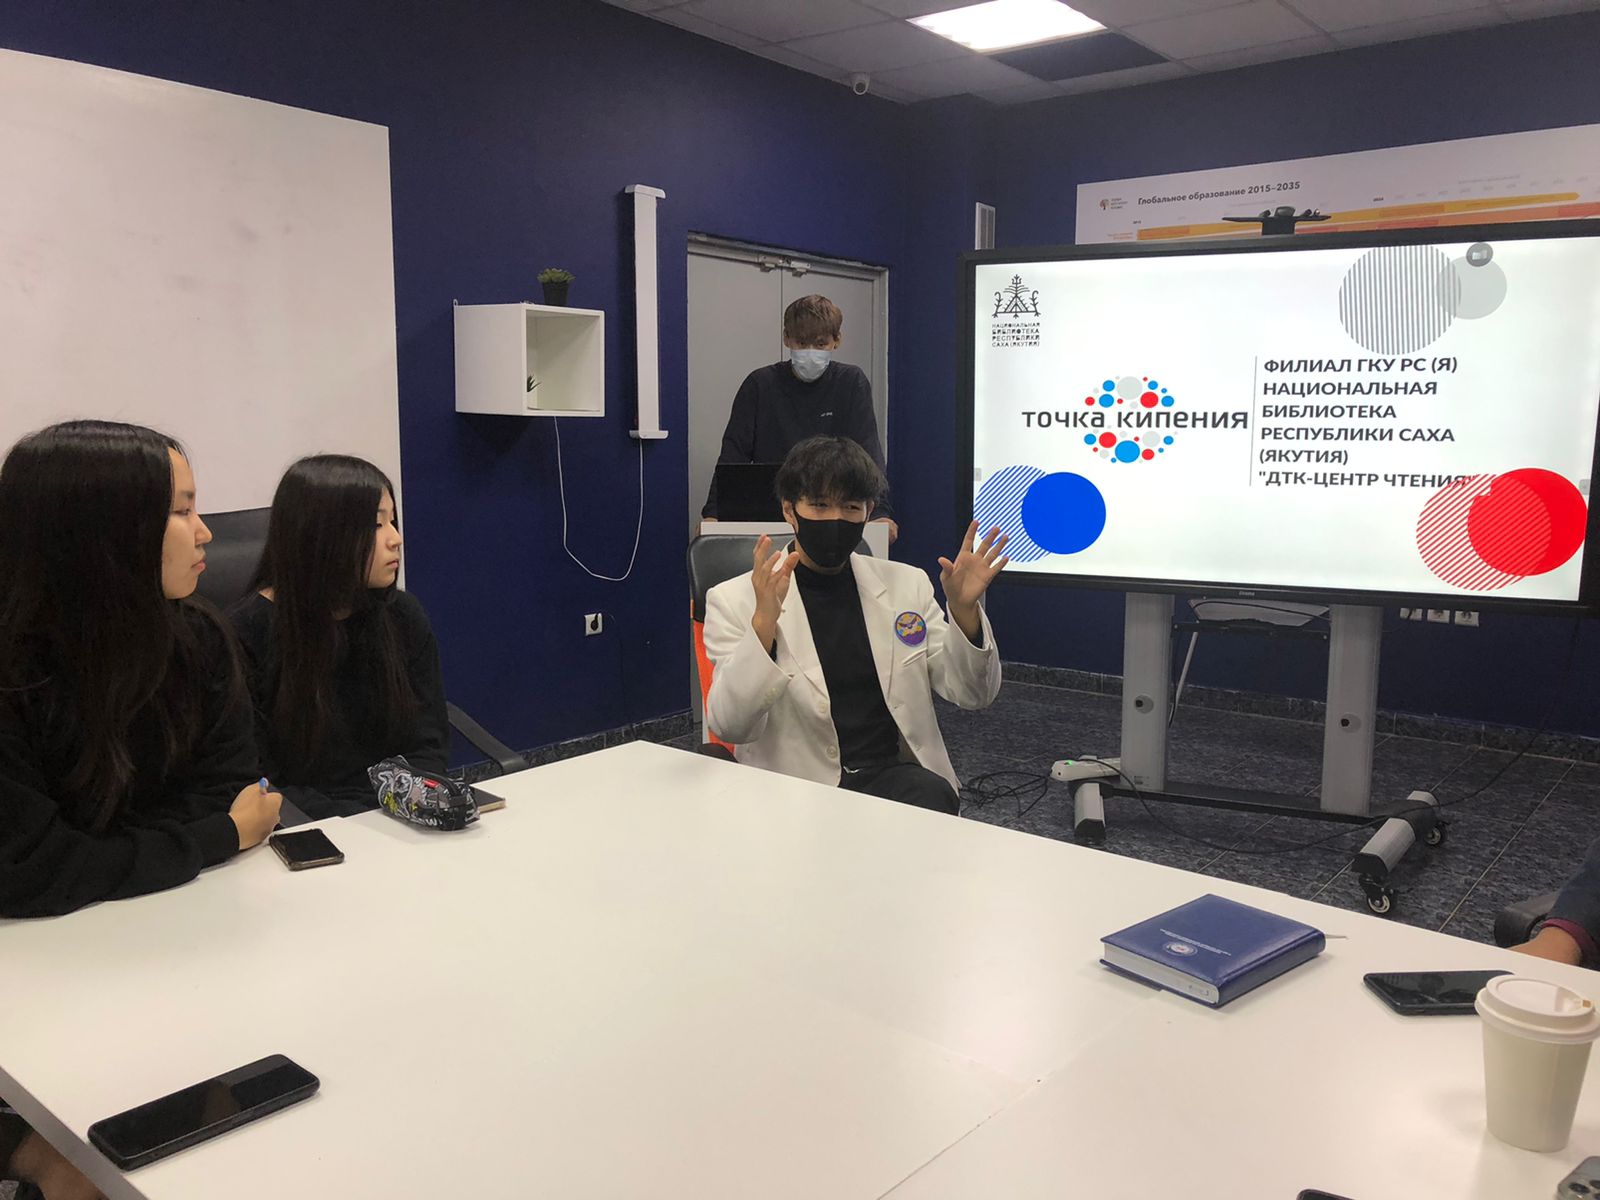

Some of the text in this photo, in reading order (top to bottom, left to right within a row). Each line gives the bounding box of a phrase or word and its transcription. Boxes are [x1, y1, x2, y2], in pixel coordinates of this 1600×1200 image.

[1137, 193, 1187, 205] Глобальное
[1188, 188, 1246, 201] образование
[1264, 357, 1458, 374] ФИЛИАЛ ГКУ РС (Я)
[1263, 381, 1438, 398] НАЦИОНАЛЬНАЯ
[1021, 411, 1249, 429] точка кипения
[1262, 405, 1397, 418] БИБЛИОТЕКА
[1261, 427, 1455, 442] РЕСПУБЛИКИ САХА
[1259, 449, 1348, 465] (ЯКУТИЯ)
[1259, 471, 1379, 488] "ДТК-ЦЕНТР
